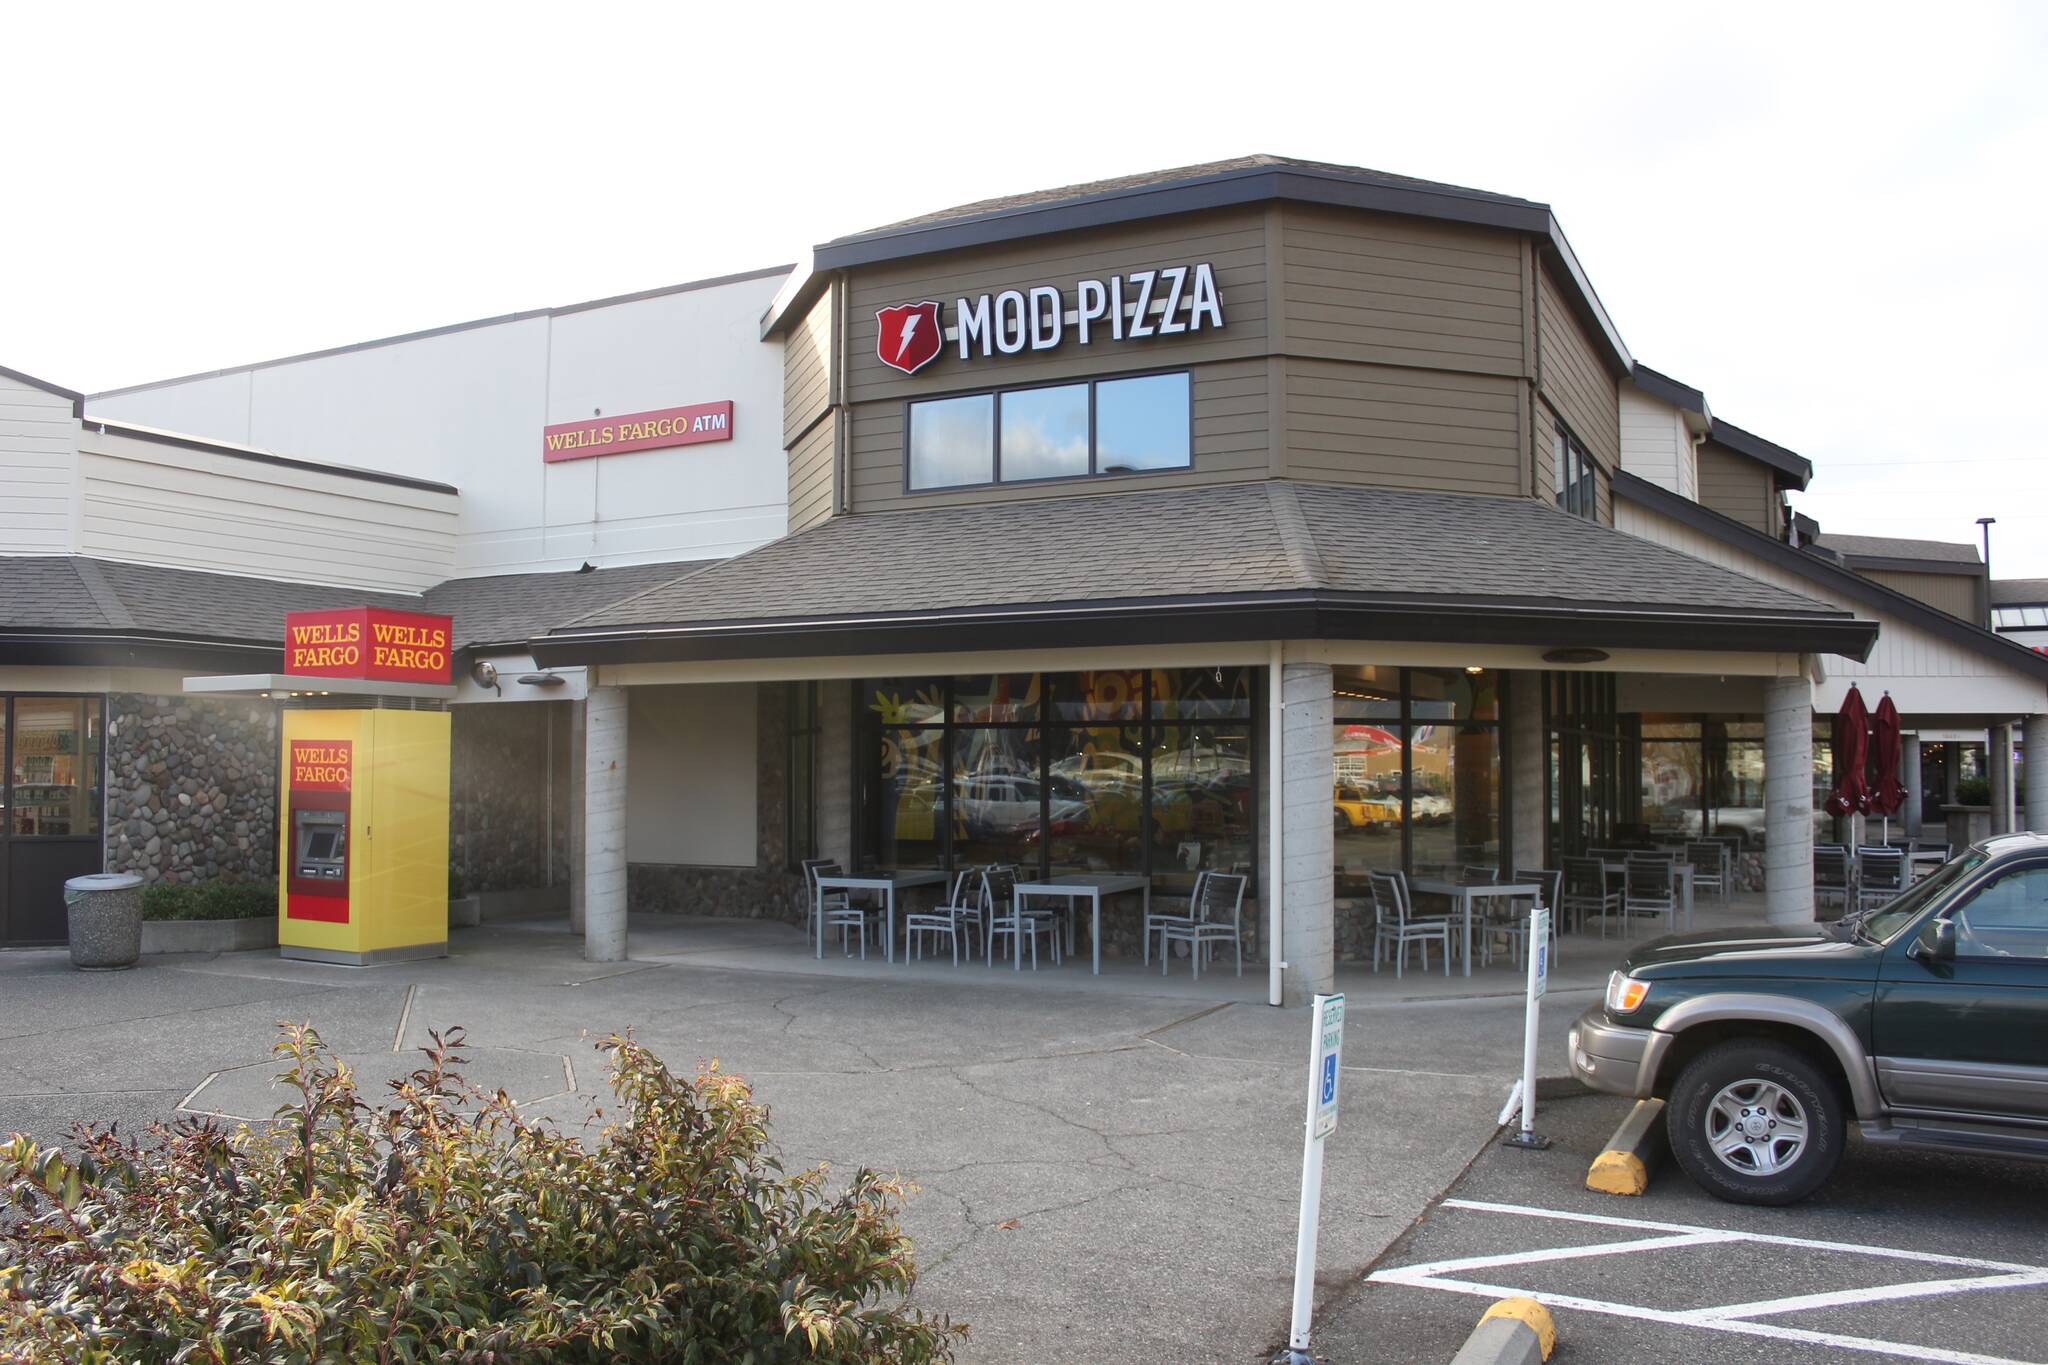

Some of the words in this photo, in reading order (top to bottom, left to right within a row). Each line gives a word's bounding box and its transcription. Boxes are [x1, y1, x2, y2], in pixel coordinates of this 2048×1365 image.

[956, 285, 1063, 361] MOD
[1077, 262, 1224, 345] PIZZA
[545, 427, 614, 451] WELLS
[618, 416, 688, 442] FARGO
[692, 413, 726, 433] ATM
[292, 623, 361, 645] WELLS
[372, 623, 446, 649] WELLS
[293, 646, 360, 668] FARGO
[373, 646, 445, 670] FARGO
[294, 748, 349, 764] WELLS
[295, 767, 348, 783] FARGO
